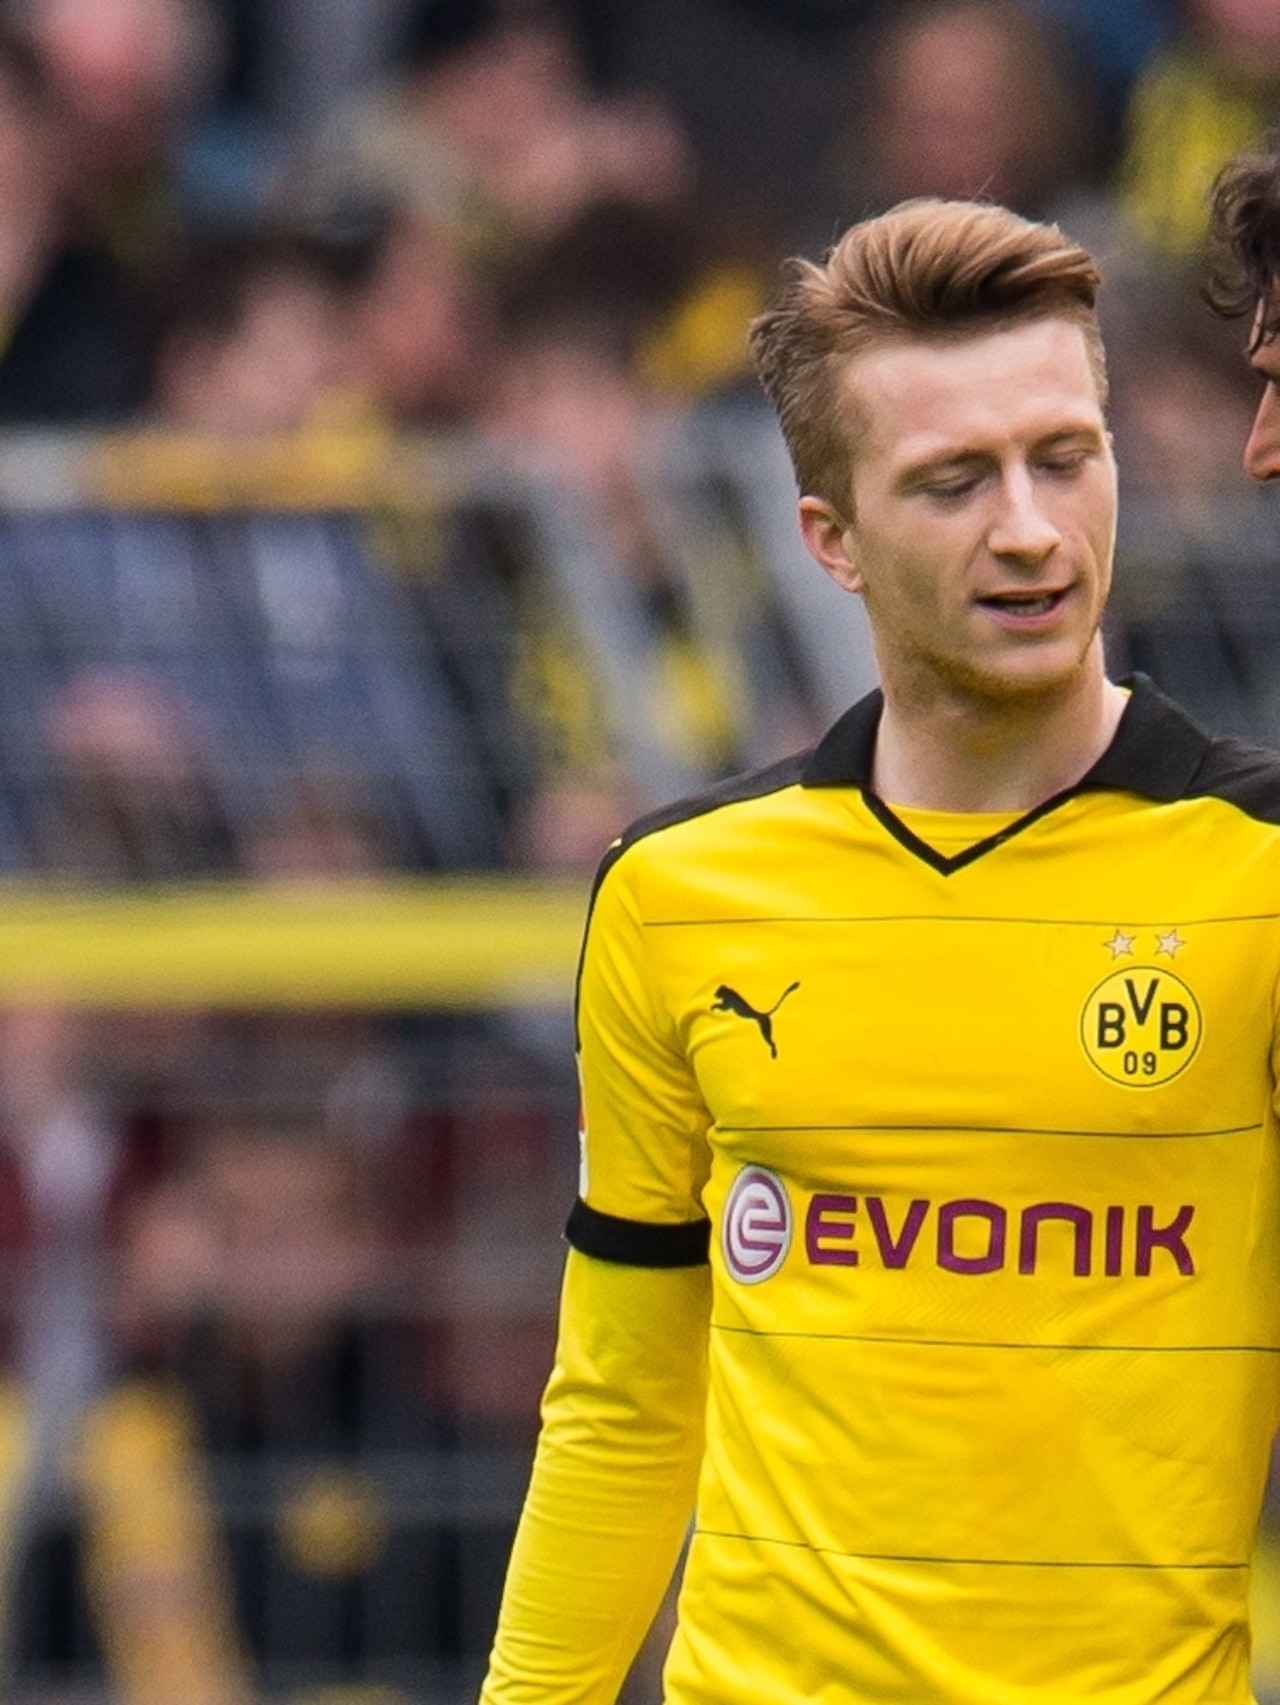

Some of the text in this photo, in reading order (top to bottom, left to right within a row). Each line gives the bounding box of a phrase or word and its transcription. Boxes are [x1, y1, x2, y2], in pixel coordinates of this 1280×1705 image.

[1097, 978, 1189, 1050] BVB
[1124, 1050, 1157, 1075] 09
[805, 1193, 1195, 1276] EVONIK
